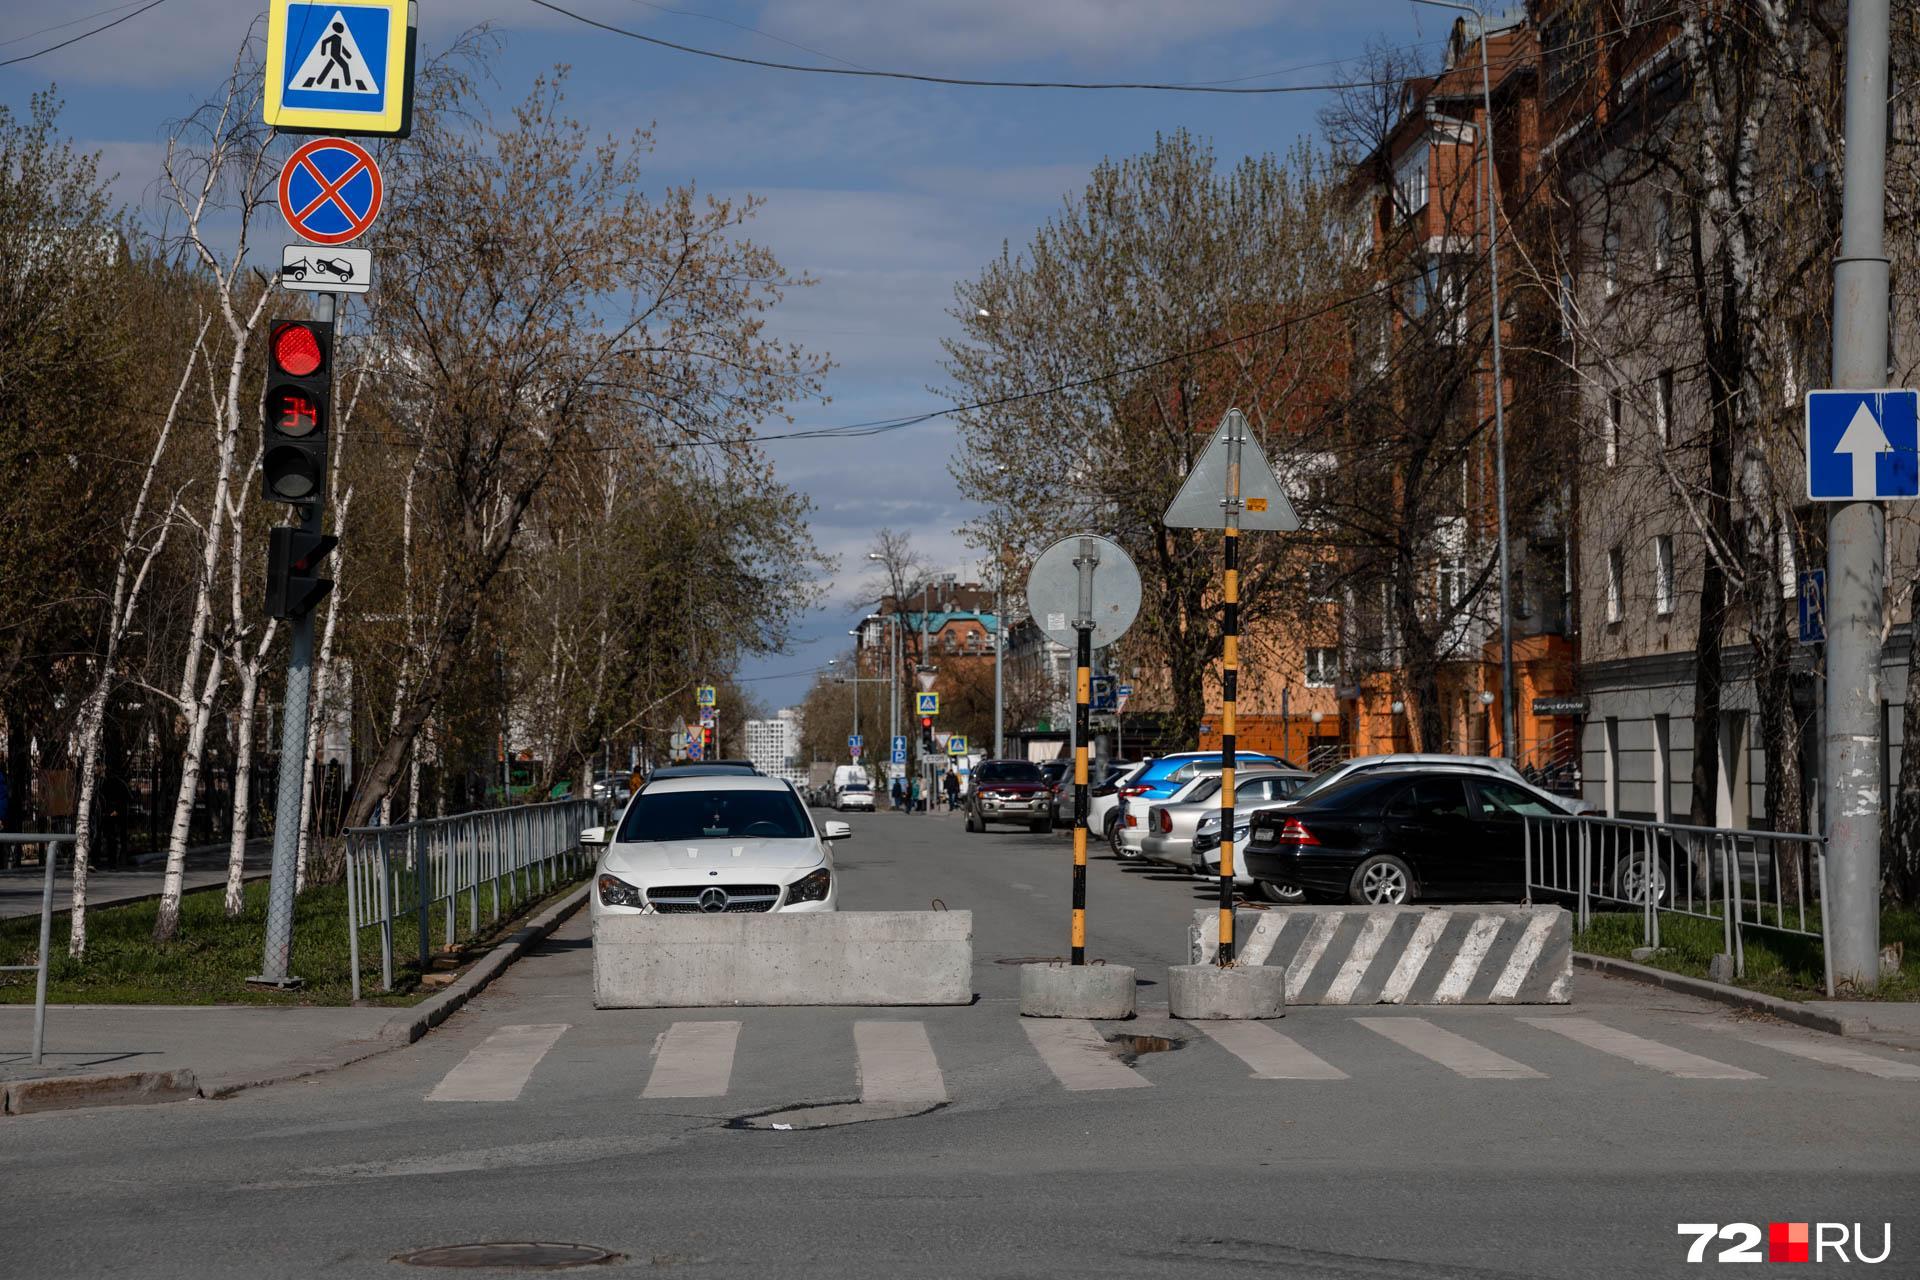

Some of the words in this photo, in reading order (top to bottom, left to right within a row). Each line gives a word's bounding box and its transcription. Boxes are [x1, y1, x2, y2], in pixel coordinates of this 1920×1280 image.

[282, 396, 317, 428] 34
[1093, 679, 1110, 706] P
[895, 750, 905, 761] P
